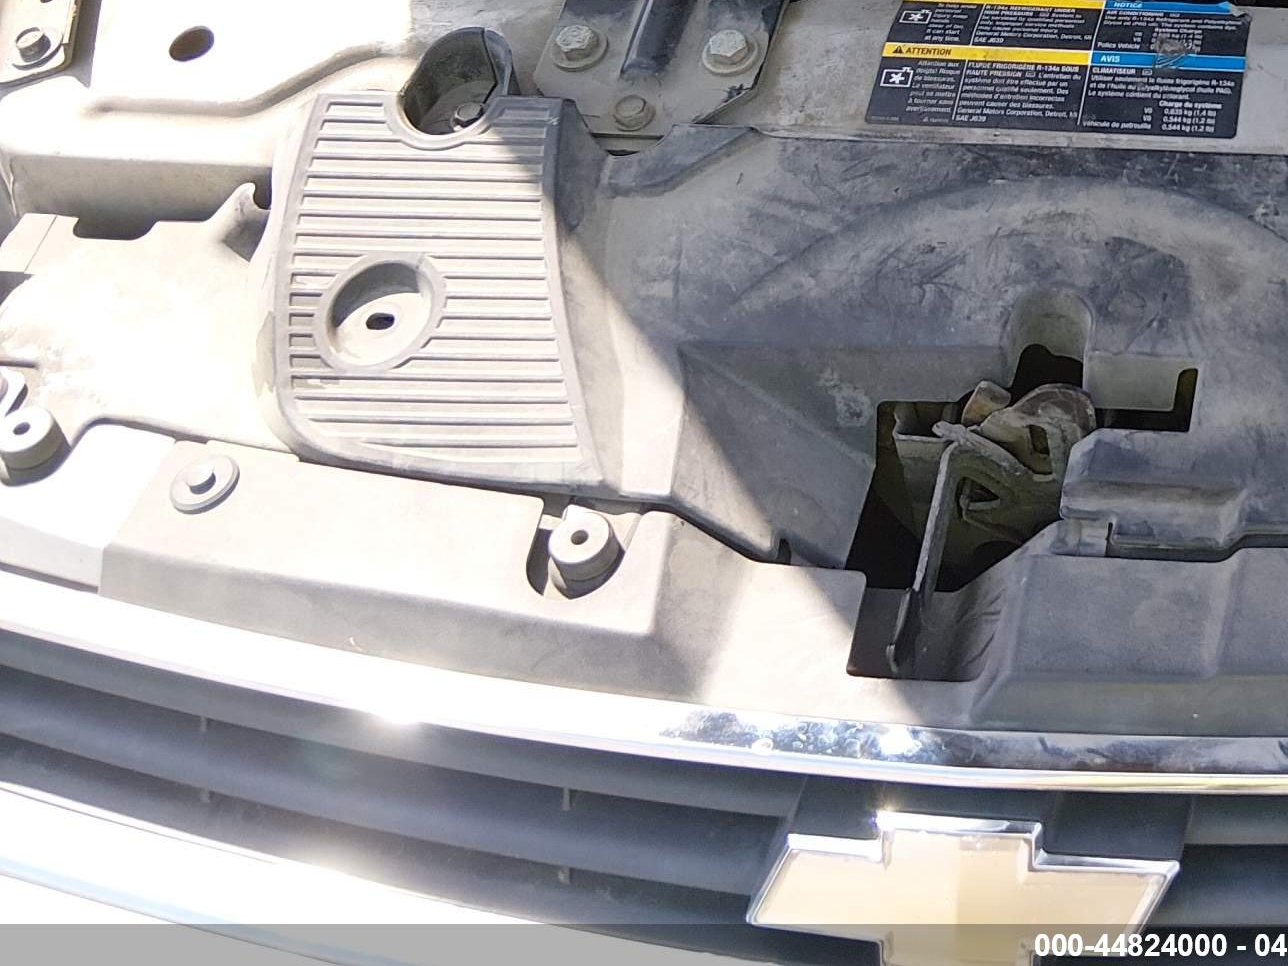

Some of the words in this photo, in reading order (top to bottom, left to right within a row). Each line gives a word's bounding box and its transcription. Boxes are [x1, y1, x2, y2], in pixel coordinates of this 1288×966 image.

[905, 47, 952, 55] ATTENTION
[1100, 55, 1120, 63] AVIS
[1092, 67, 1136, 75] CLIMATISEUR
